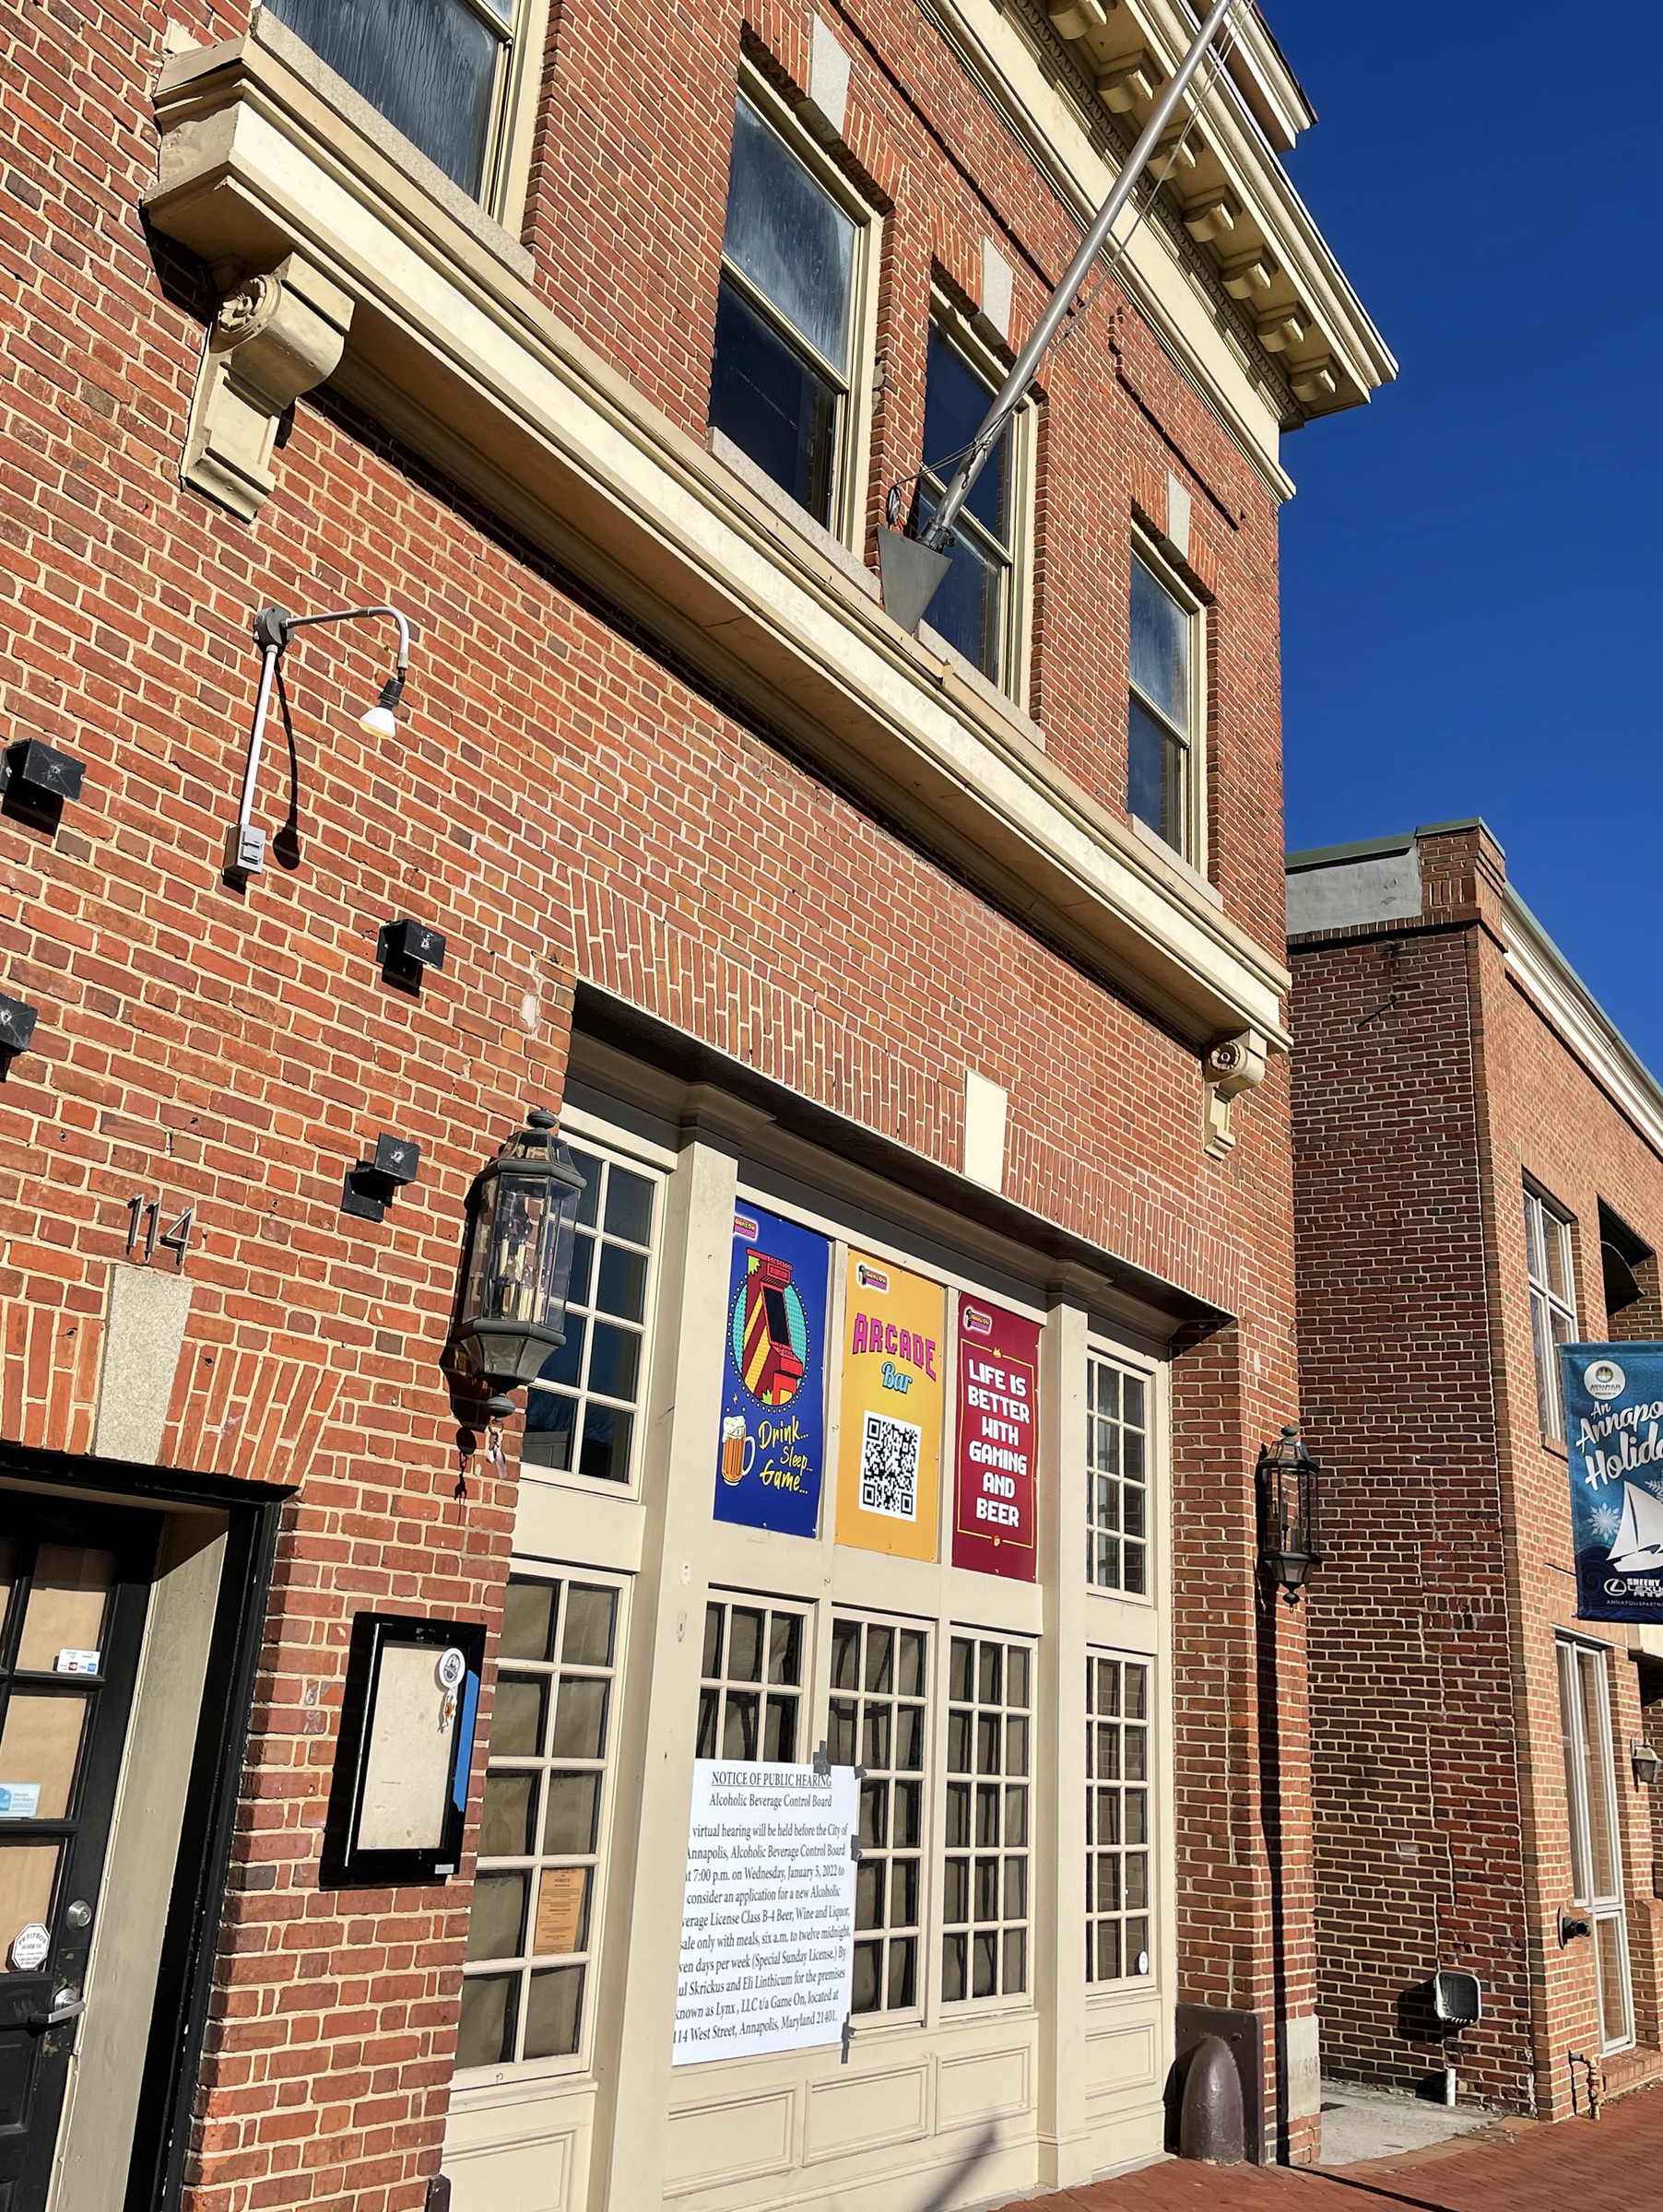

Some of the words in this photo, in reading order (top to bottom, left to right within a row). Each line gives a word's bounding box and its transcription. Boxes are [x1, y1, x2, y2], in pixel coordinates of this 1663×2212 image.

[127, 1194, 193, 1262] 114
[852, 1312, 937, 1382] ARCADE
[881, 1361, 913, 1394] Bar
[969, 1359, 1006, 1390] LIFE
[1009, 1374, 1027, 1397] IS
[968, 1384, 1030, 1424] BETTER
[1591, 1401, 1611, 1419] An
[981, 1416, 1019, 1446] WITH
[969, 1441, 1027, 1476] GAMING
[983, 1471, 1015, 1499] AND
[976, 1497, 1019, 1528] BEER
[1627, 1578, 1661, 1587] SHEEHY
[1627, 1585, 1663, 1594] LEXU
[712, 1771, 748, 1785] NOTICE
[749, 1771, 761, 1785] OF
[763, 1772, 794, 1786] PUBLIC
[795, 1773, 832, 1787] HEARING
[709, 1793, 748, 1806] Alcoholic
[749, 1794, 783, 1811] Beverage
[784, 1794, 811, 1807] Control
[812, 1794, 832, 1807] Board
[692, 1823, 720, 1837] virtual
[721, 1823, 751, 1841] hearing
[752, 1823, 766, 1837] will
[767, 1823, 776, 1837] be
[777, 1823, 793, 1836] held
[794, 1823, 816, 1836] before
[816, 1823, 827, 1836] the
[828, 1823, 841, 1840] City
[841, 1822, 849, 1836] of
[730, 1844, 767, 1859] Alcoholic
[768, 1844, 799, 1861] Beverage
[800, 1843, 826, 1857] Control
[827, 1843, 845, 1856] Board
[693, 1868, 712, 1882] 7:00
[713, 1871, 730, 1885] p.m.
[732, 1870, 742, 1881] on
[744, 1865, 786, 1882] Wednesday,
[786, 1865, 814, 1881] January
[815, 1865, 821, 1878] 5,
[822, 1865, 838, 1877] 2022
[838, 1865, 845, 1877] to
[687, 1889, 723, 1904] consider
[724, 1893, 734, 1903] an
[735, 1888, 776, 1906] application
[778, 1886, 788, 1900] for
[789, 1890, 794, 1900] a
[795, 1888, 809, 1900] new
[810, 1884, 841, 1899] Alcoholic
[710, 1912, 740, 1926] License
[741, 1910, 761, 1924] Class
[762, 1909, 774, 1923] B-4
[776, 1908, 794, 1923] Beer,
[796, 1906, 814, 1920] Wine
[815, 1905, 828, 1919] and
[829, 1905, 850, 1921] Liquor,
[697, 1934, 715, 1953] only
[717, 1933, 735, 1947] with
[737, 1931, 761, 1947] meals,
[761, 1931, 772, 1945] six
[773, 1932, 788, 1944] a.m.
[790, 1931, 797, 1942] to
[798, 1926, 820, 1941] twelve
[695, 1958, 714, 1976] days
[715, 1959, 730, 1975] per
[731, 1953, 750, 1969] week
[752, 1950, 781, 1971] (Special
[782, 1948, 808, 1966] Sunday
[808, 1946, 837, 1961] License.)
[838, 1946, 846, 1961] By
[689, 1979, 725, 1996] Skrickus
[725, 1976, 741, 1992] and
[743, 1975, 753, 1991] Eli
[754, 1973, 793, 1989] Linthicum
[794, 1971, 805, 1984] for
[806, 1969, 817, 1983] the
[818, 1967, 845, 1985] premises
[705, 2006, 714, 2017] as
[741, 1997, 758, 2013] LLC
[759, 1995, 769, 2011] t/a
[771, 1994, 793, 2008] Game
[793, 1992, 807, 2006] On,
[808, 1987, 832, 2004] located
[832, 1989, 839, 2001] at
[673, 2029, 688, 2043] 114
[690, 2027, 711, 2041] West
[712, 2024, 737, 2039] Street,
[739, 2017, 780, 2037] Annapolis,
[781, 2011, 815, 2031] Maryland
[816, 2009, 838, 2024] 21401.
